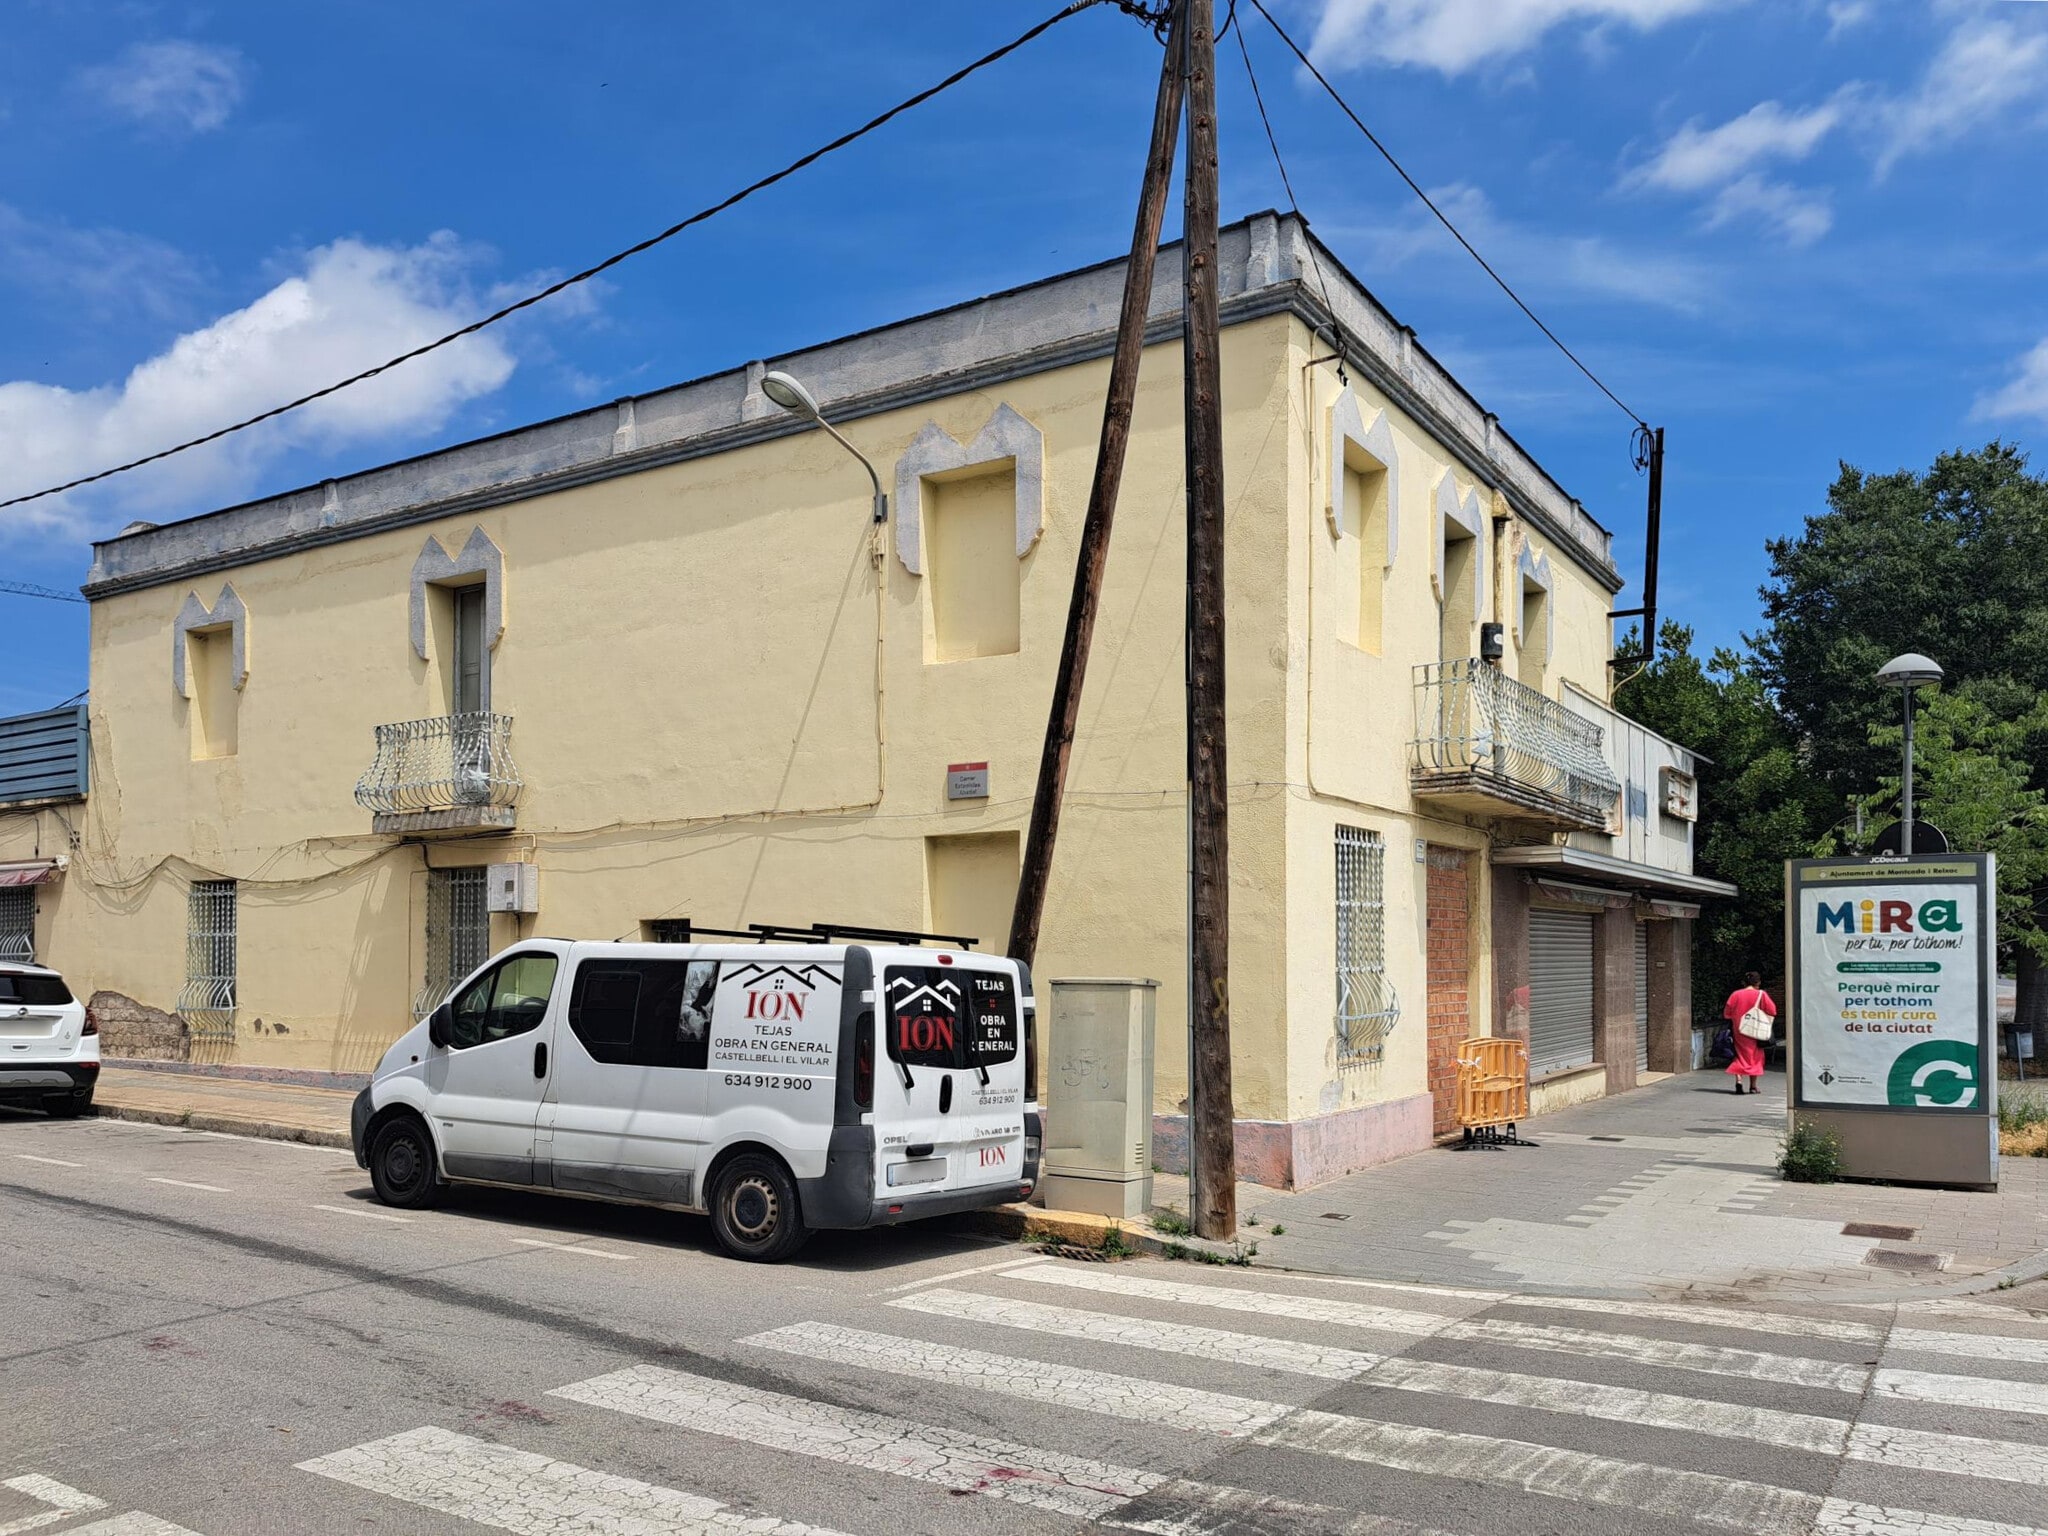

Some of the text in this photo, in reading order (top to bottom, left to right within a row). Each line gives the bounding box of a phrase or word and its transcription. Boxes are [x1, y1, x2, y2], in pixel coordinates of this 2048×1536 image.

[1845, 935, 1964, 952] per tu, per tothom!
[975, 980, 1005, 991] TEJAS
[1838, 982, 1940, 995] Perquè mirar
[744, 990, 809, 1022] ION
[1845, 996, 1932, 1008] per tothom
[981, 1015, 1006, 1025] OBRA
[1841, 1008, 1937, 1020] és tenir cura
[755, 1025, 792, 1036] TEJAS
[897, 1016, 955, 1051] ION
[988, 1028, 1001, 1038] EN
[1845, 1022, 1933, 1033] de la ciutat
[715, 1038, 832, 1053] OBRA EN GENERAL
[715, 1052, 779, 1063] CASTELLBELL
[786, 1056, 797, 1064] EL
[800, 1057, 829, 1066] VILAR
[724, 1074, 812, 1090] 634 912 900
[979, 1095, 1015, 1105] 634 912 900
[884, 1136, 907, 1144] OPEL
[980, 1146, 1005, 1167] ION
